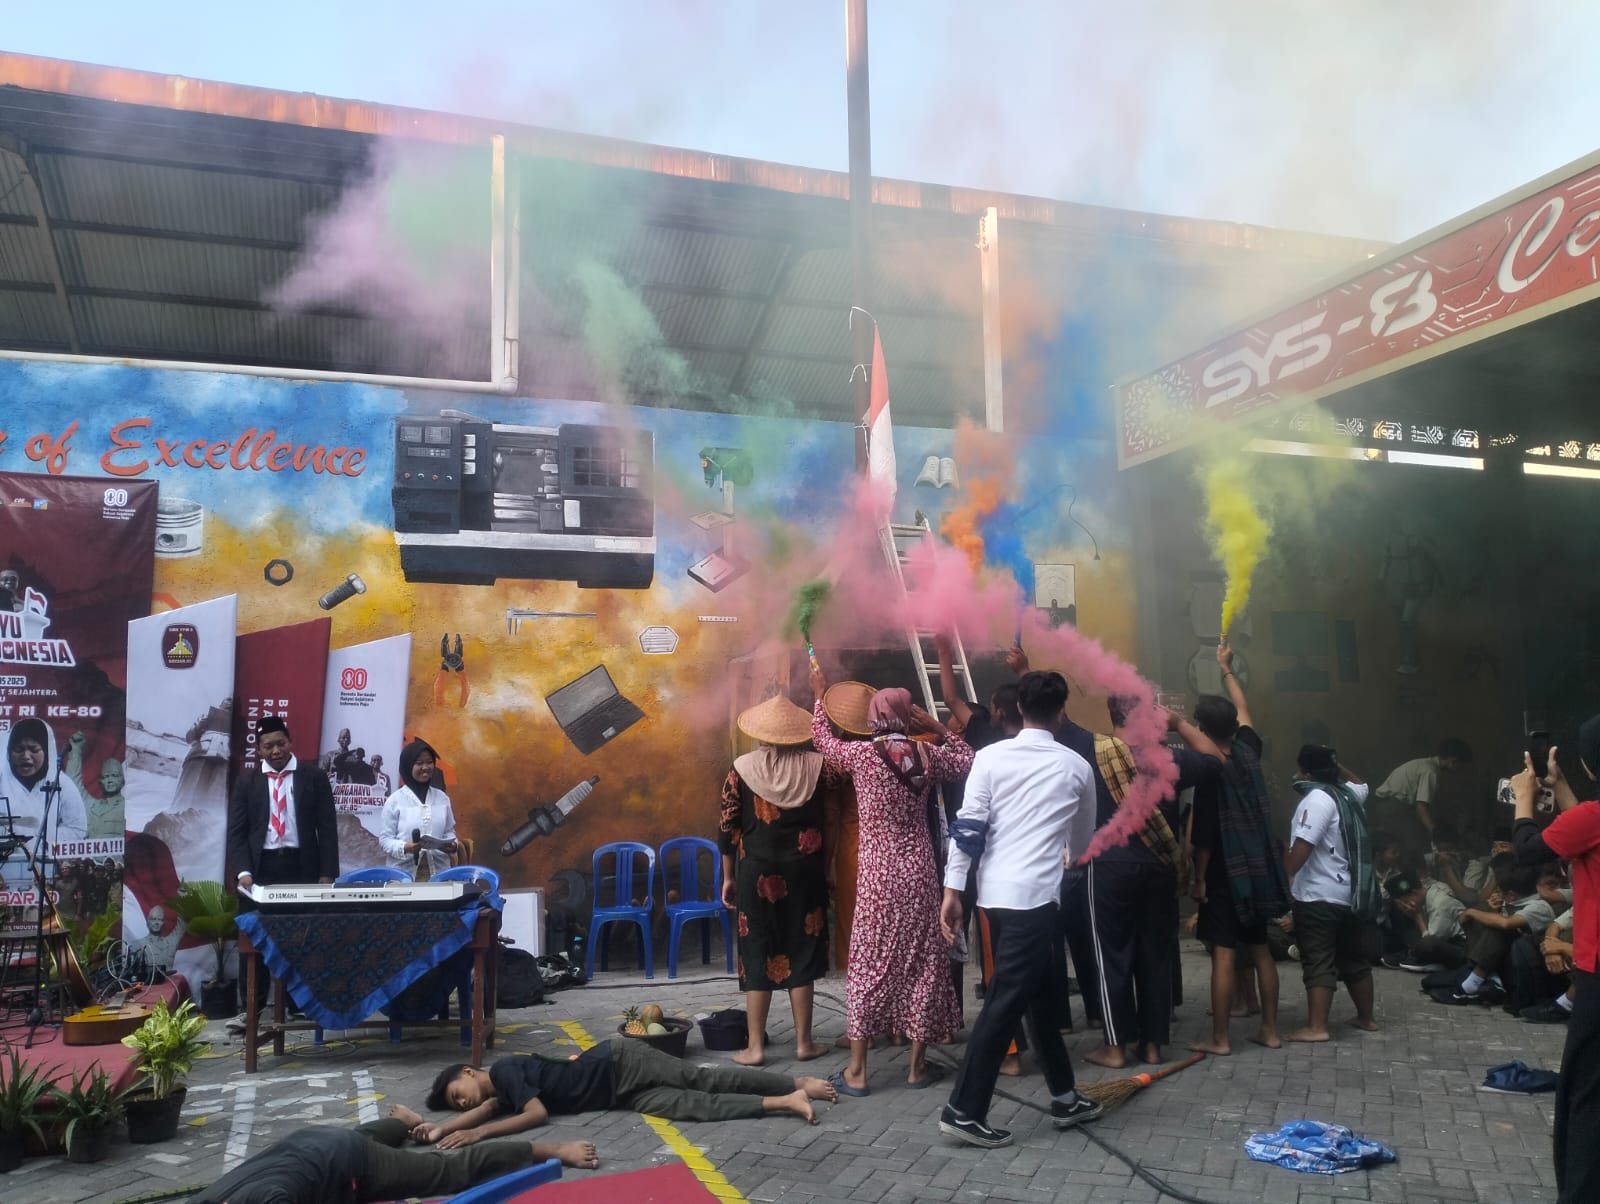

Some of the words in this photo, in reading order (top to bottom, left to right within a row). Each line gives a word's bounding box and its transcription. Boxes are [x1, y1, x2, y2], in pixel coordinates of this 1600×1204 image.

[1201, 269, 1438, 409] SYS-8
[24, 420, 80, 476] of
[100, 417, 368, 477] Excellence
[104, 488, 128, 506] 80
[0, 641, 71, 664] ONESIA
[7, 677, 25, 685] 2025
[341, 667, 368, 690] 80
[19, 706, 35, 716] RI
[47, 706, 102, 716] KE-80
